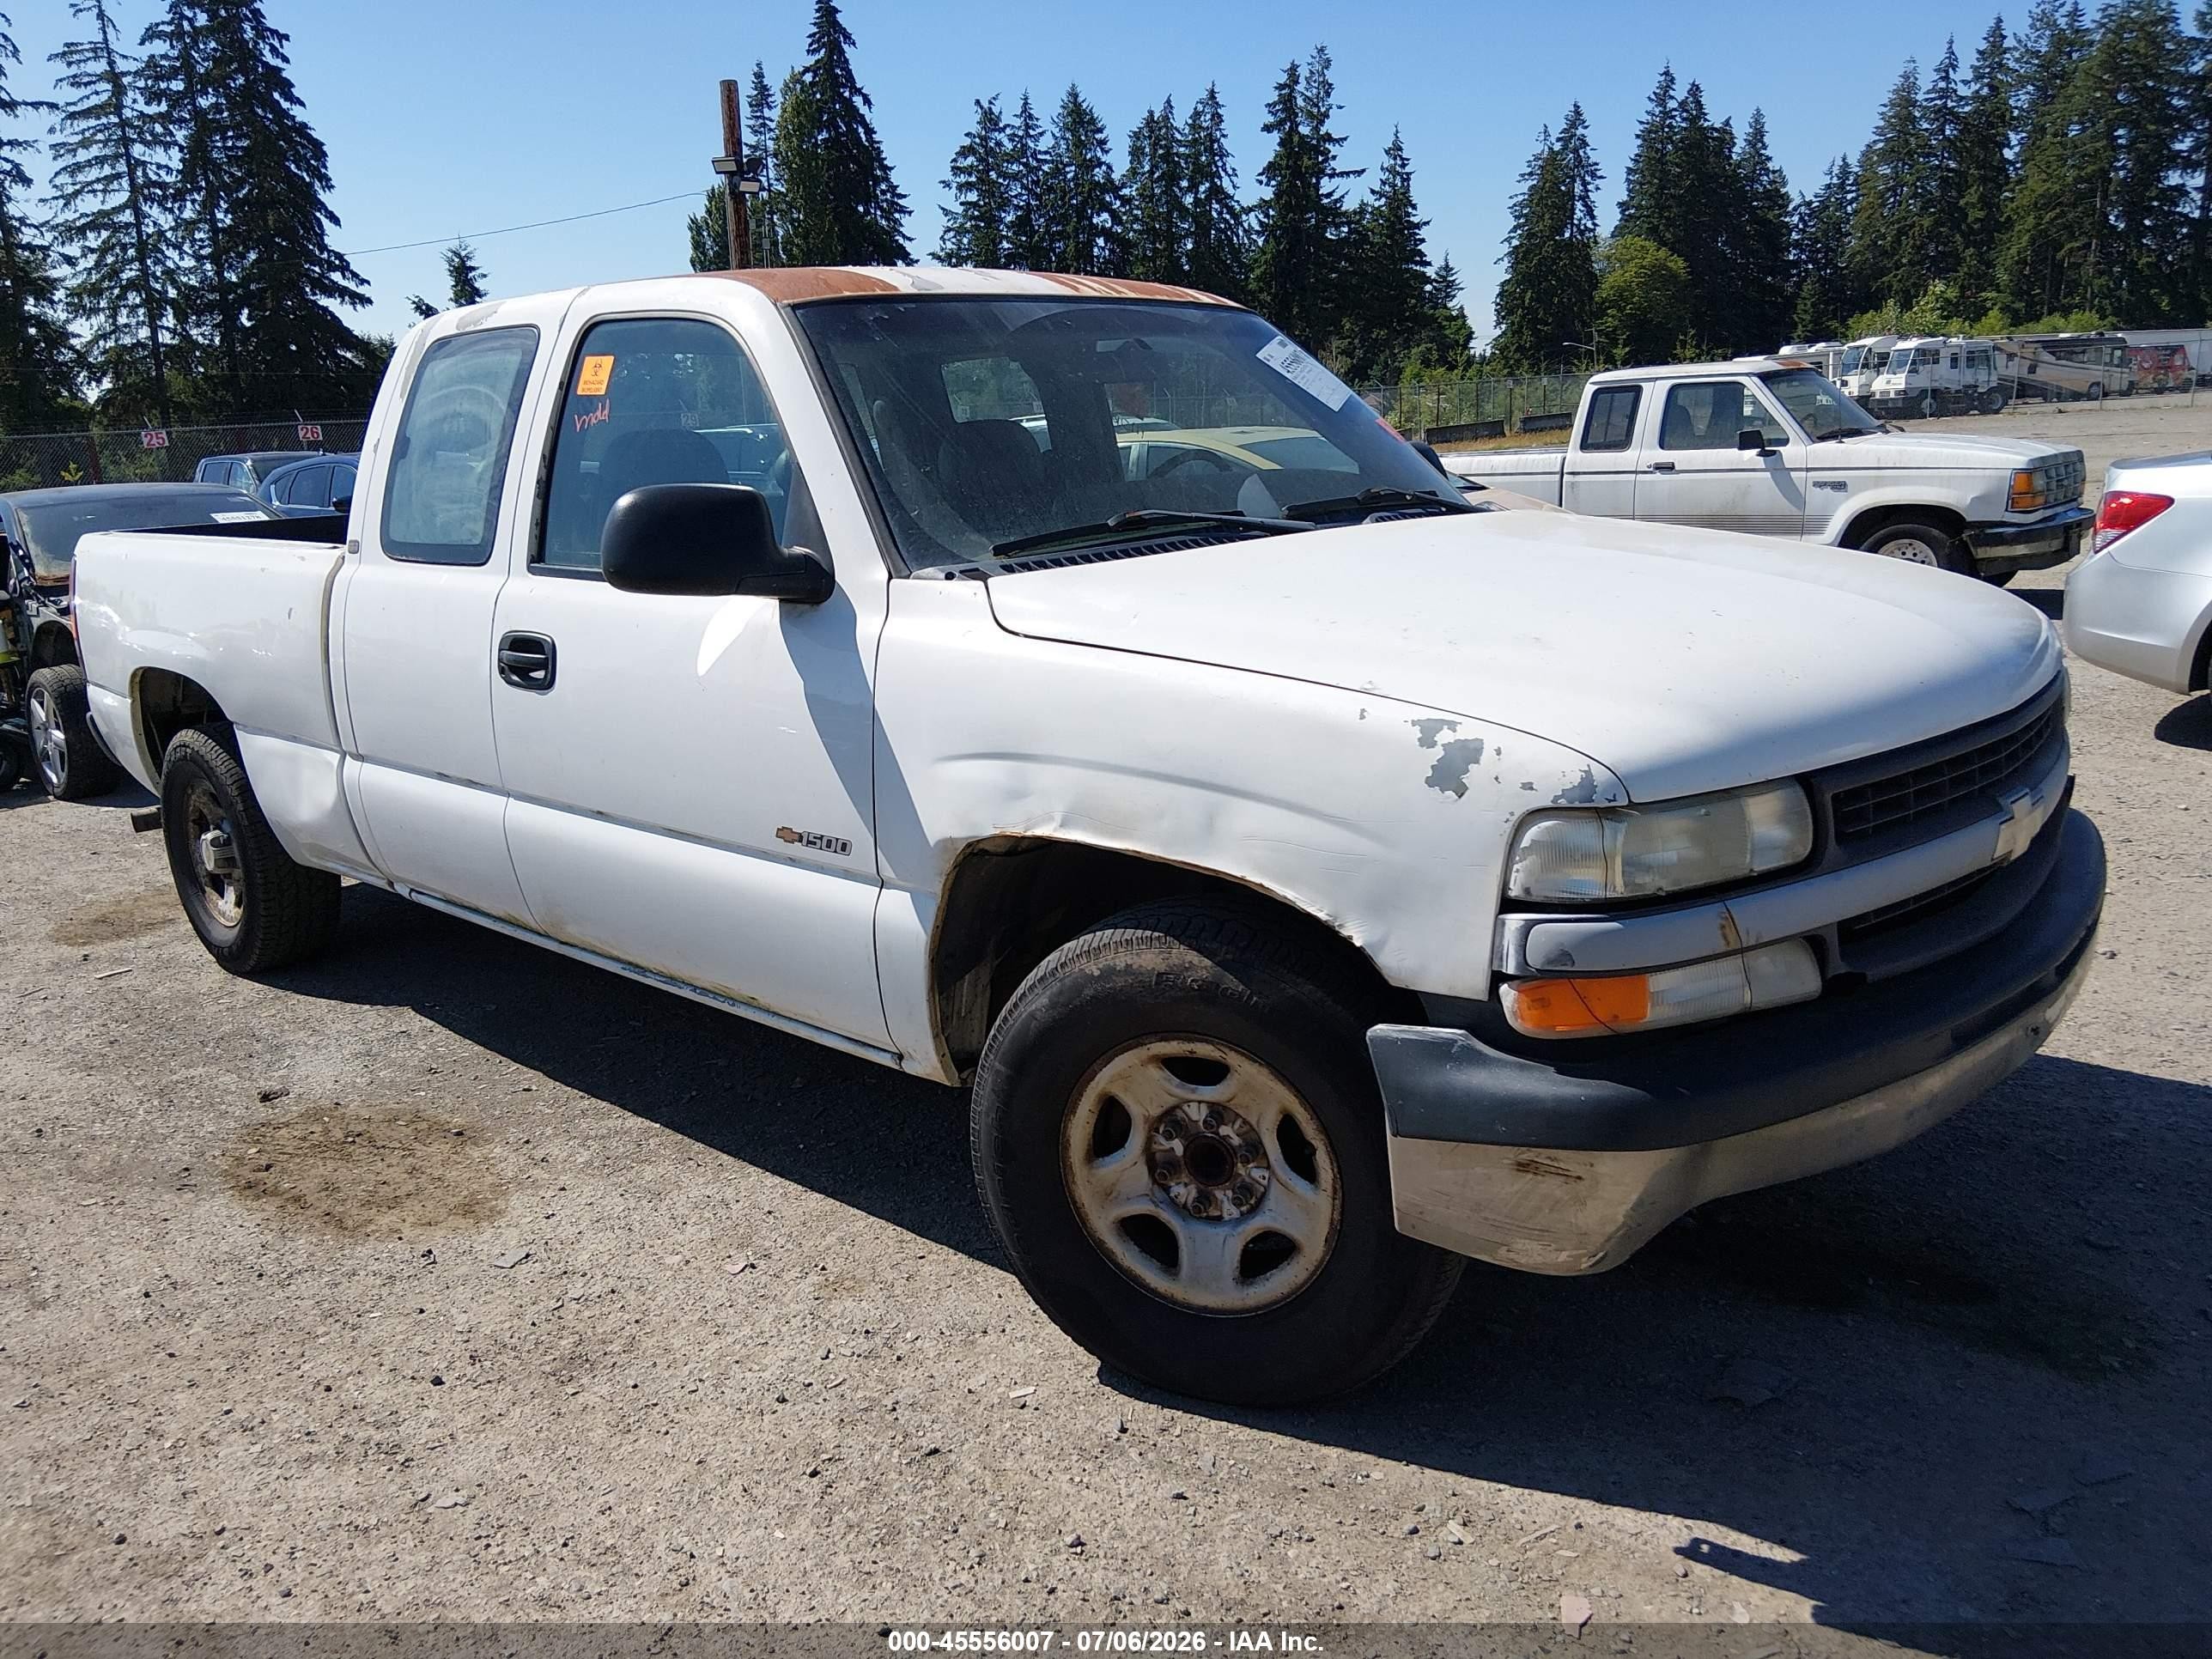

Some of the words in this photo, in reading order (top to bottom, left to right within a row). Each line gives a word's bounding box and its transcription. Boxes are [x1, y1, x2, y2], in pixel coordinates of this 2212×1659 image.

[143, 432, 166, 447] 25
[301, 426, 320, 441] 26
[801, 830, 853, 856] 1500
